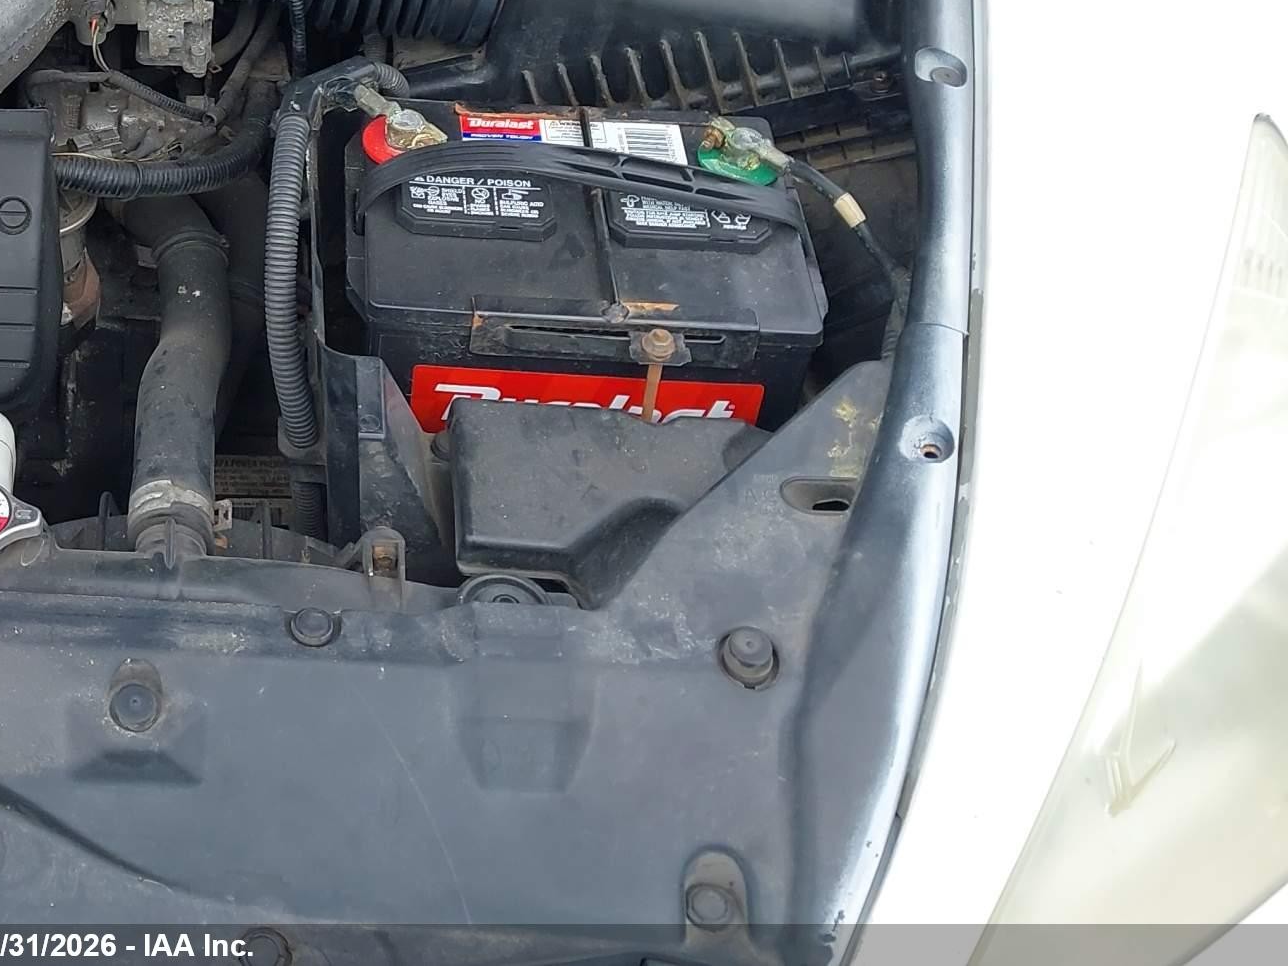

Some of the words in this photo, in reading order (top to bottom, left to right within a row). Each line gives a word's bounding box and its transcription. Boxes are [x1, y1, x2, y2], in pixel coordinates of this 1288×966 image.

[467, 117, 534, 129] Duralast
[426, 175, 475, 186] DANGER
[478, 178, 486, 186] /
[487, 178, 532, 188] POISON
